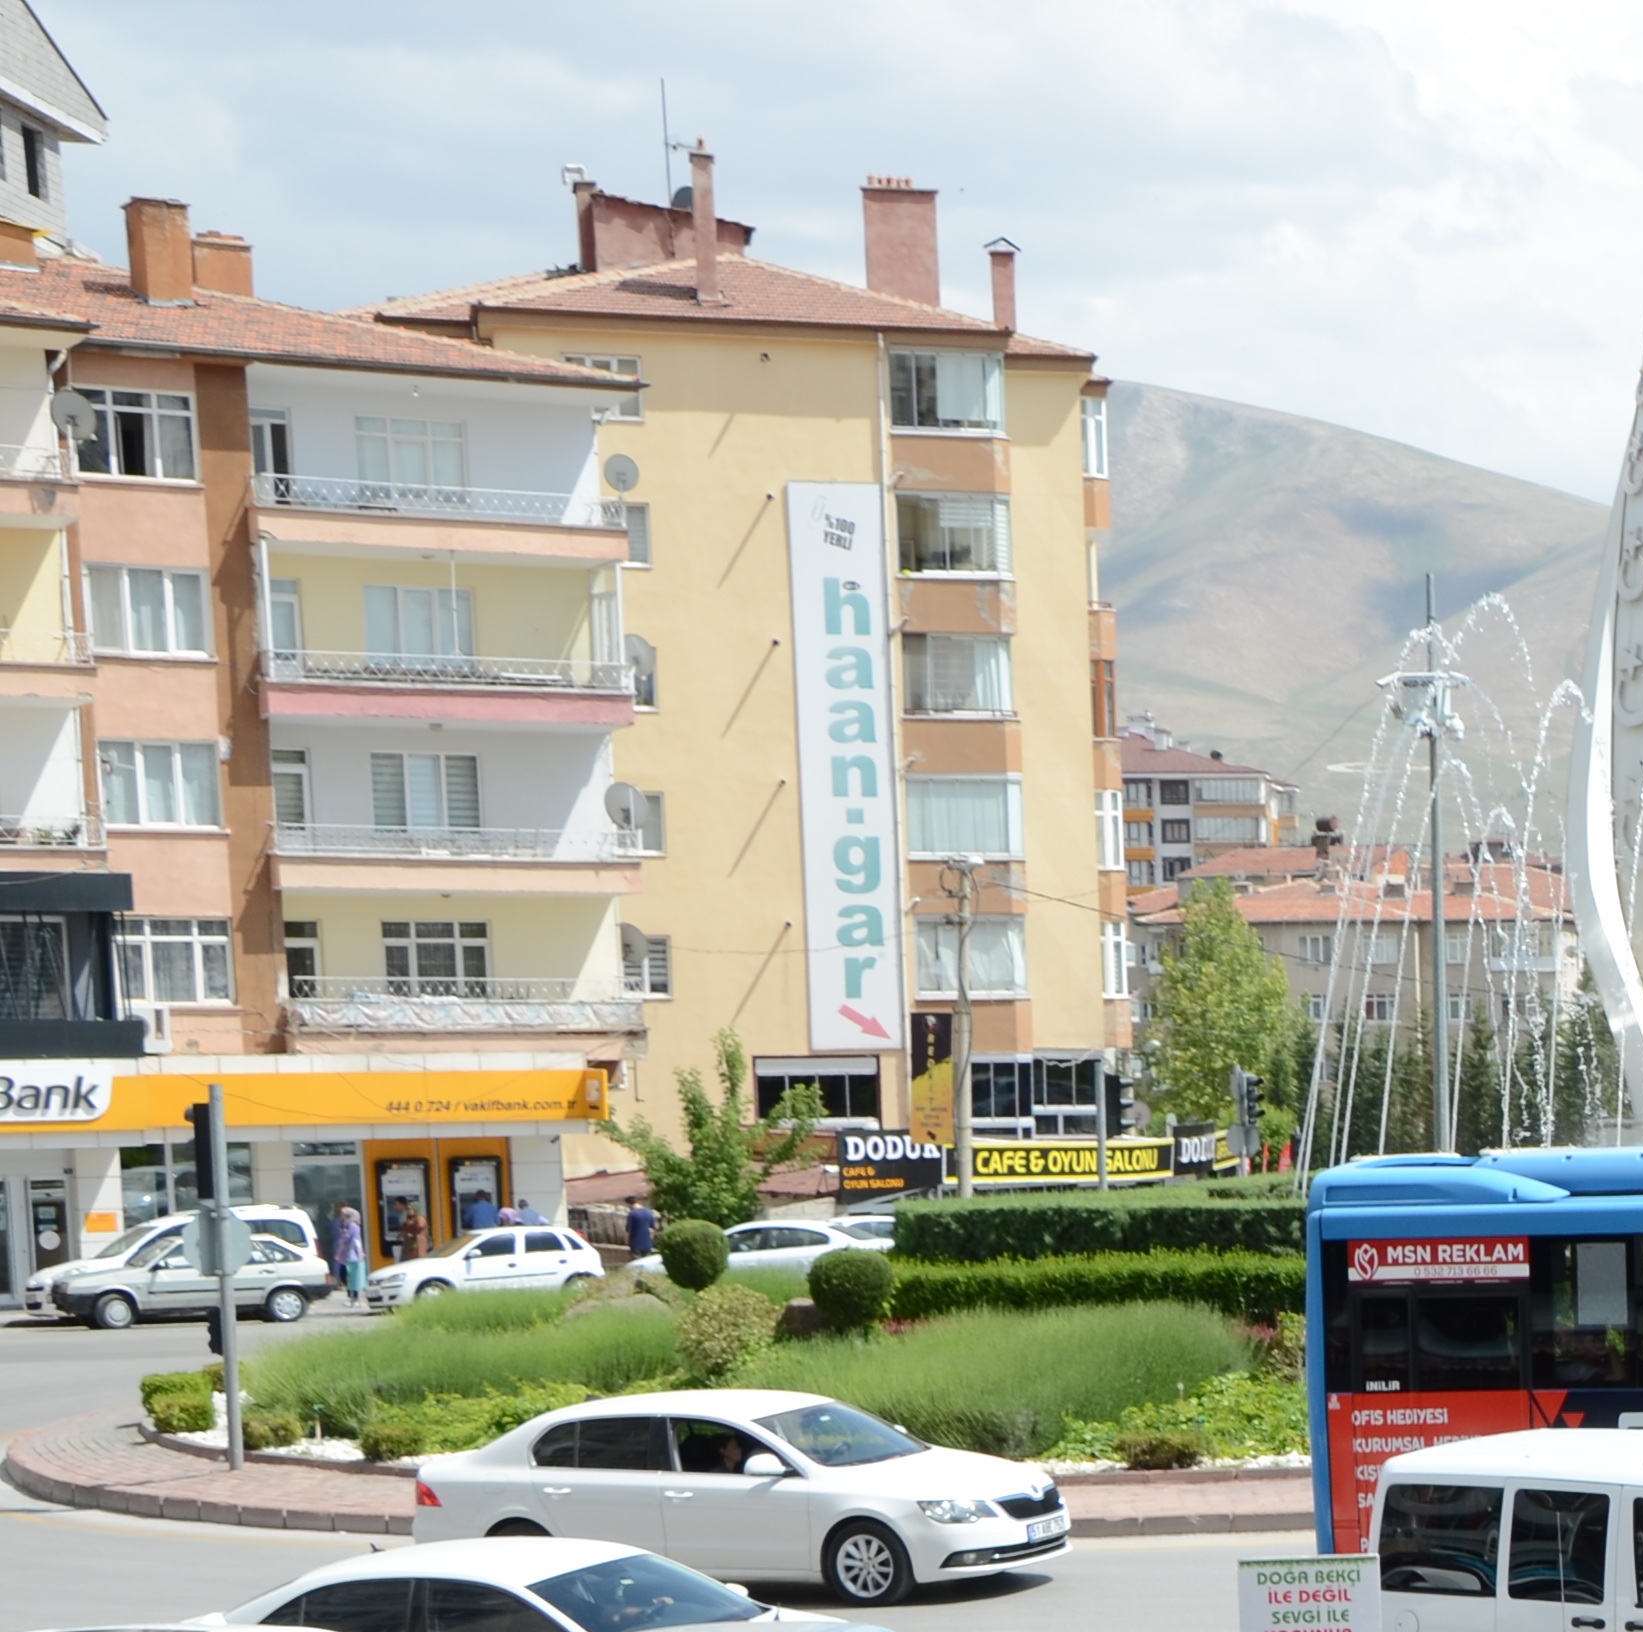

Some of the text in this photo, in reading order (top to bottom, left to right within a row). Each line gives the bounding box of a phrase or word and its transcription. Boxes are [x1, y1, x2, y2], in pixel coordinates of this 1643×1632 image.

[976, 1148, 1159, 1173] CAFE & OYUN SALONU
[842, 1165, 867, 1177] CAFE
[1386, 1242, 1525, 1264] MSN REKLAM
[1413, 1265, 1498, 1277] 0 532 713 66 66
[1351, 1408, 1449, 1425] OFİS HEDİYESİ
[1353, 1436, 1428, 1453] KURUMSAL
[1256, 1564, 1361, 1587] DOĞA BEKÇİ
[1268, 1584, 1352, 1604] İLE DEĞİL
[1271, 1608, 1350, 1625] SEVGİ İLE
